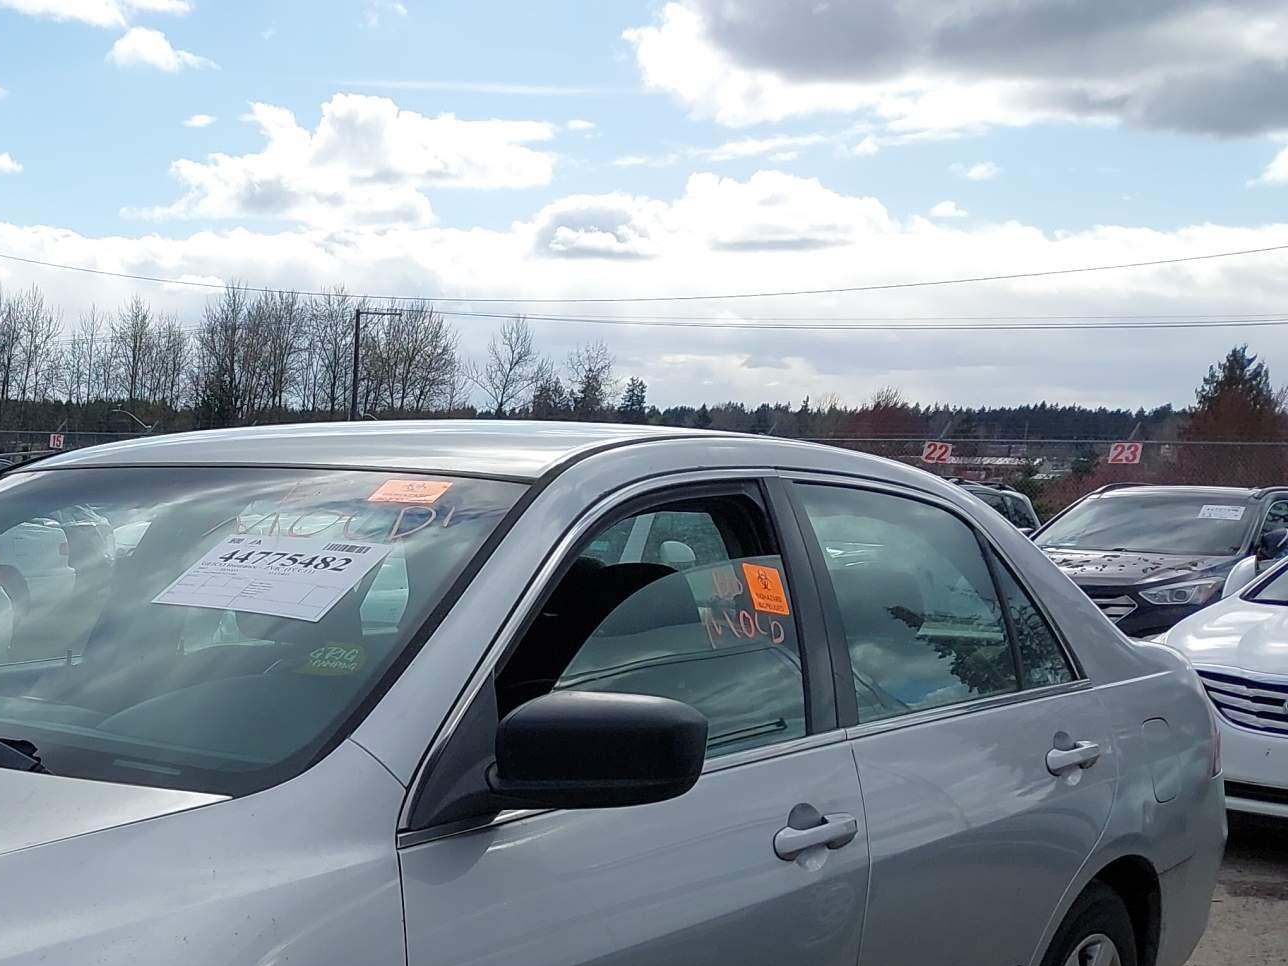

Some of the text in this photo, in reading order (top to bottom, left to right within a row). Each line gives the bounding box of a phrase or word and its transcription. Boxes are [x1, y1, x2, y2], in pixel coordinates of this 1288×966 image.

[51, 435, 62, 448] 15
[924, 443, 951, 463] 22
[1112, 443, 1140, 463] 23
[219, 549, 352, 572] 44775482
